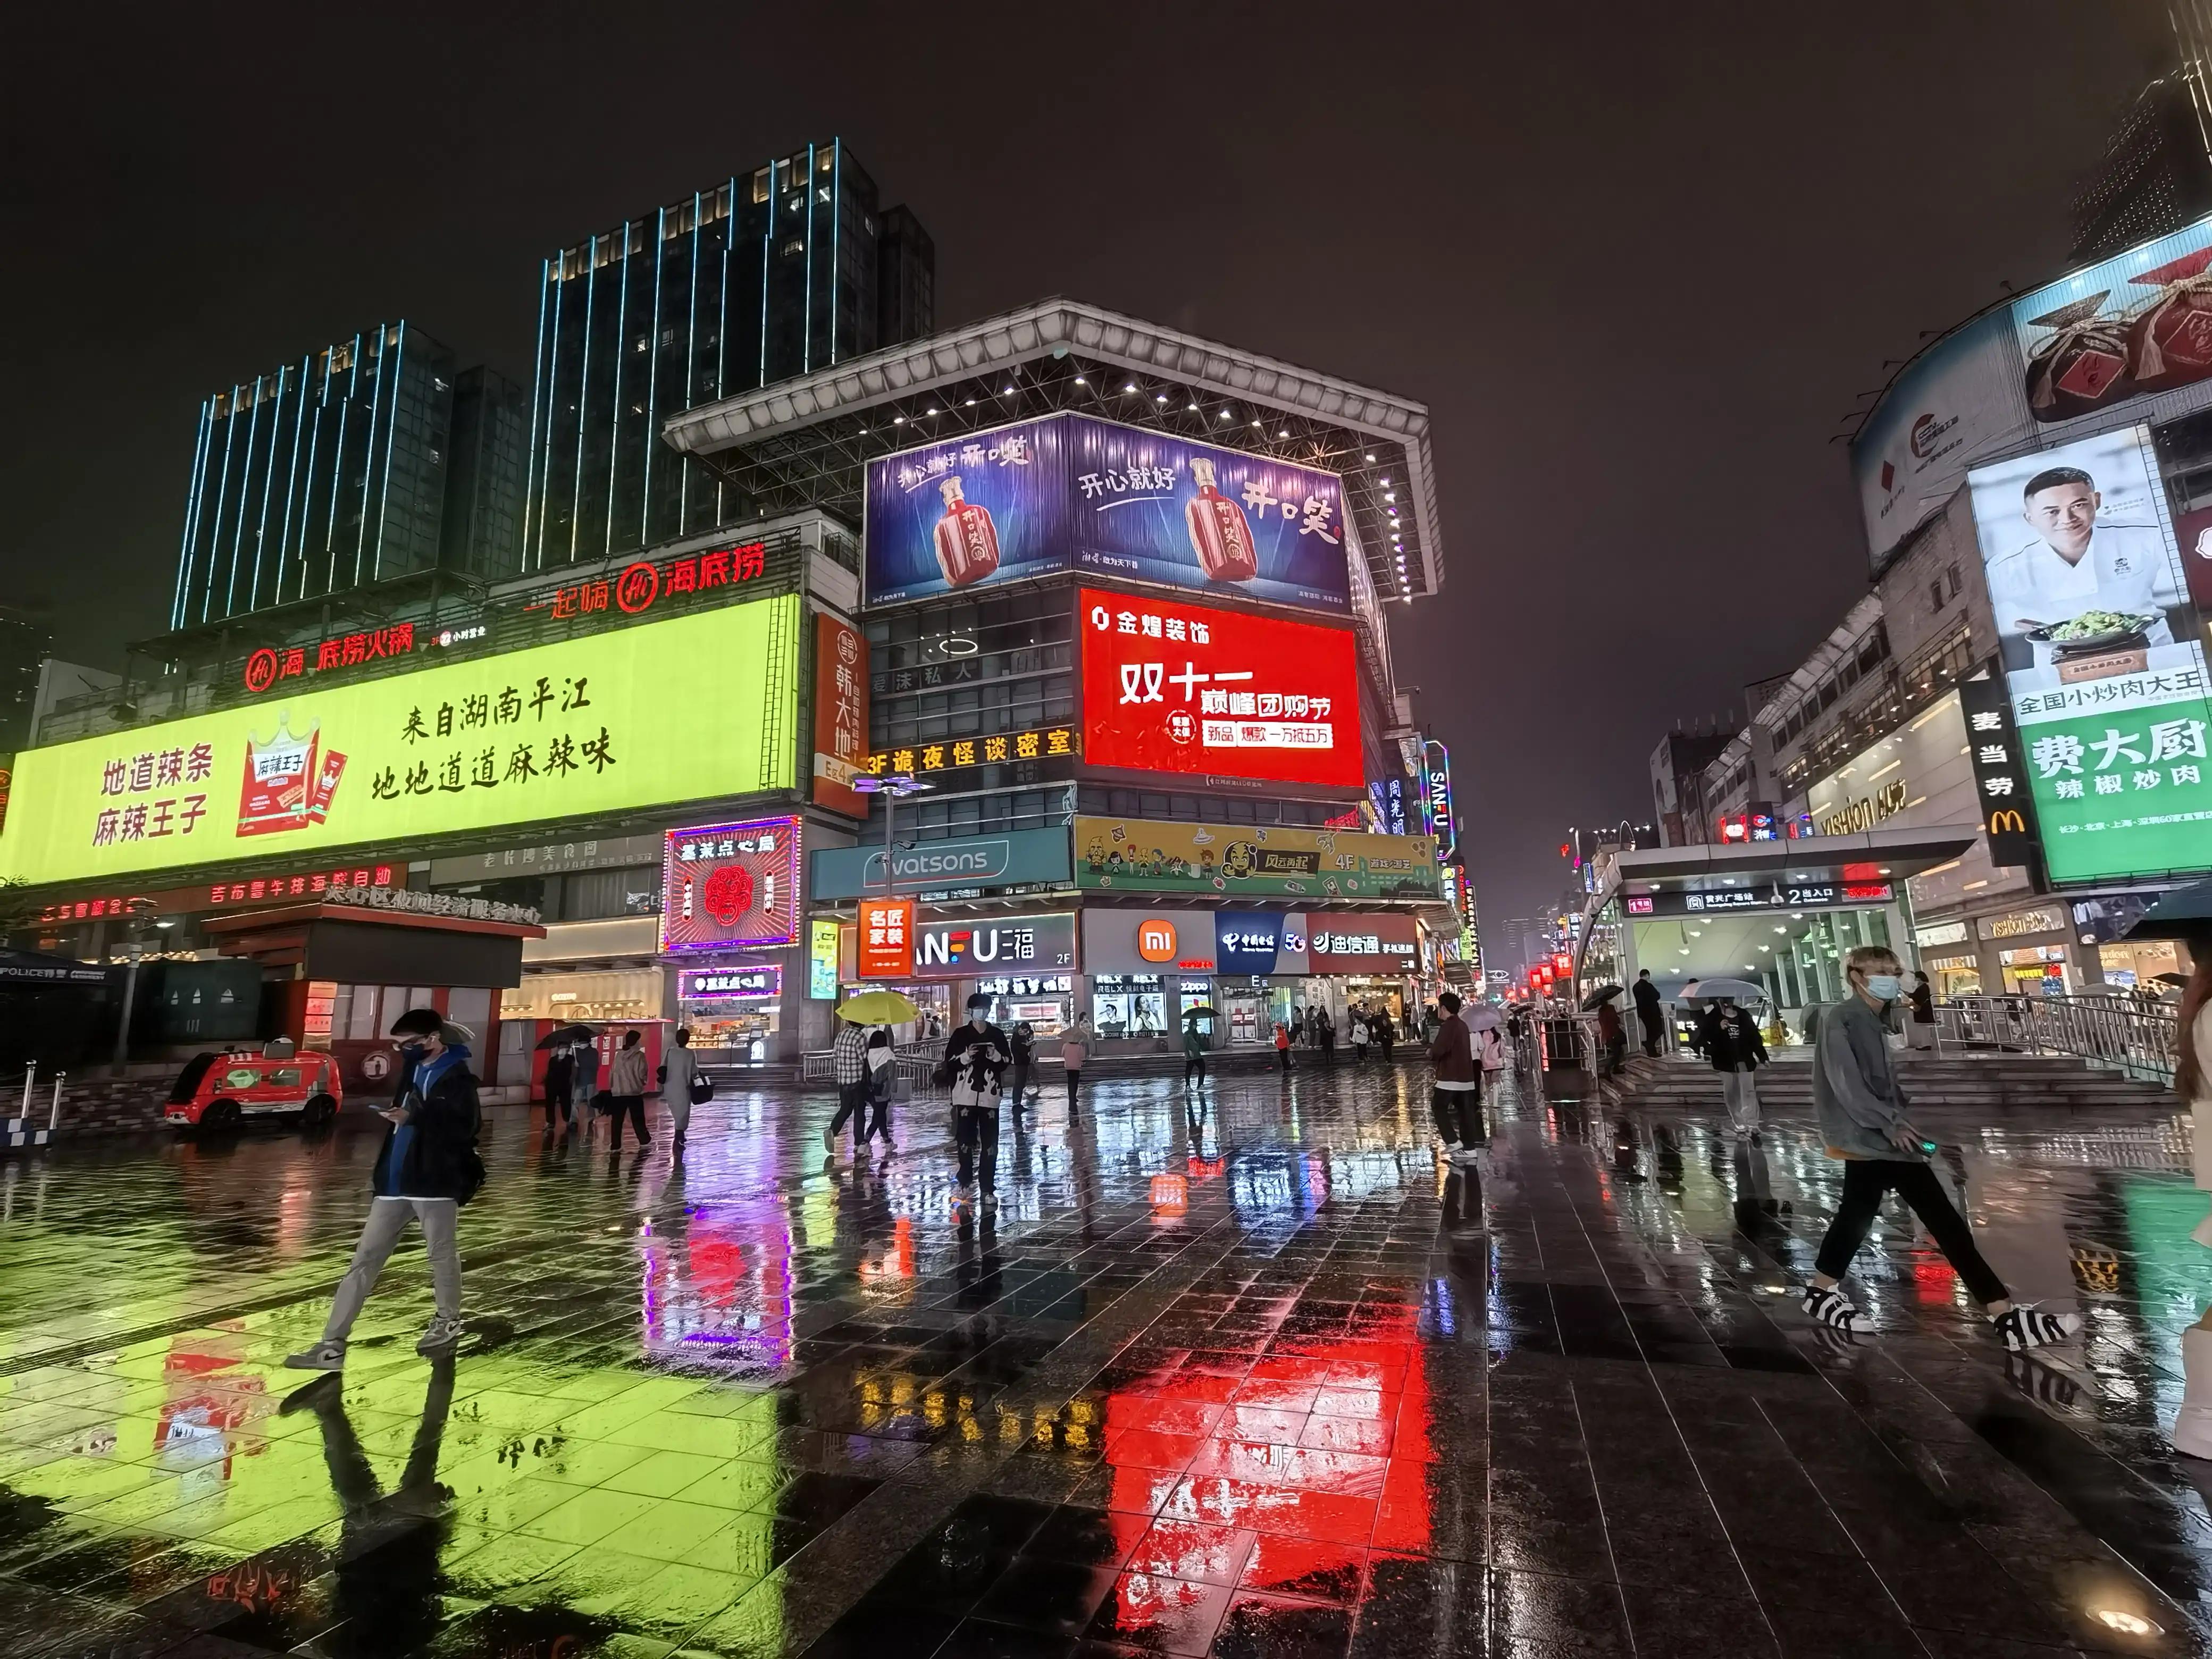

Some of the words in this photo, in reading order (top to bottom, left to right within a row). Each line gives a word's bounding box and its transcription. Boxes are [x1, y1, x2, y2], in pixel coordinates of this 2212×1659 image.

[961, 435, 1029, 467] 开口笑
[898, 453, 957, 488] 开心就好
[1078, 467, 1176, 499] 开心就好
[1215, 501, 1239, 543] 开口笑
[1242, 481, 1339, 544] 开口笑
[665, 542, 765, 598] 海底捞
[524, 581, 608, 620] 一起嗨
[1117, 611, 1210, 644] 金煌装饰
[1120, 661, 1253, 705] 双十一
[2017, 671, 2202, 716] 全国小炒肉大王
[401, 677, 591, 745] 来自湖南平江
[834, 664, 852, 761] 韩大地
[1201, 689, 1331, 720] 巅峰团购节
[1208, 726, 1234, 742] 新品
[2031, 718, 2207, 780] 费大厨
[100, 742, 214, 797] 地道辣条
[372, 727, 617, 801] 地地道道麻辣味
[1971, 711, 2014, 797] 麦当劳
[2055, 765, 2200, 800] 辣椒炒肉
[92, 794, 207, 848] 麻辣王子
[1389, 780, 1405, 836] 周光明
[1335, 853, 1356, 871] 4F
[1788, 889, 1802, 904] 2
[1803, 889, 1833, 898] 出入口
[869, 909, 904, 927] 名匠
[869, 928, 904, 945] 家装
[1002, 928, 1034, 961] 三福
[1285, 933, 1306, 952] 5G
[1330, 935, 1379, 954] 迪信通
[1057, 953, 1070, 965] 2F
